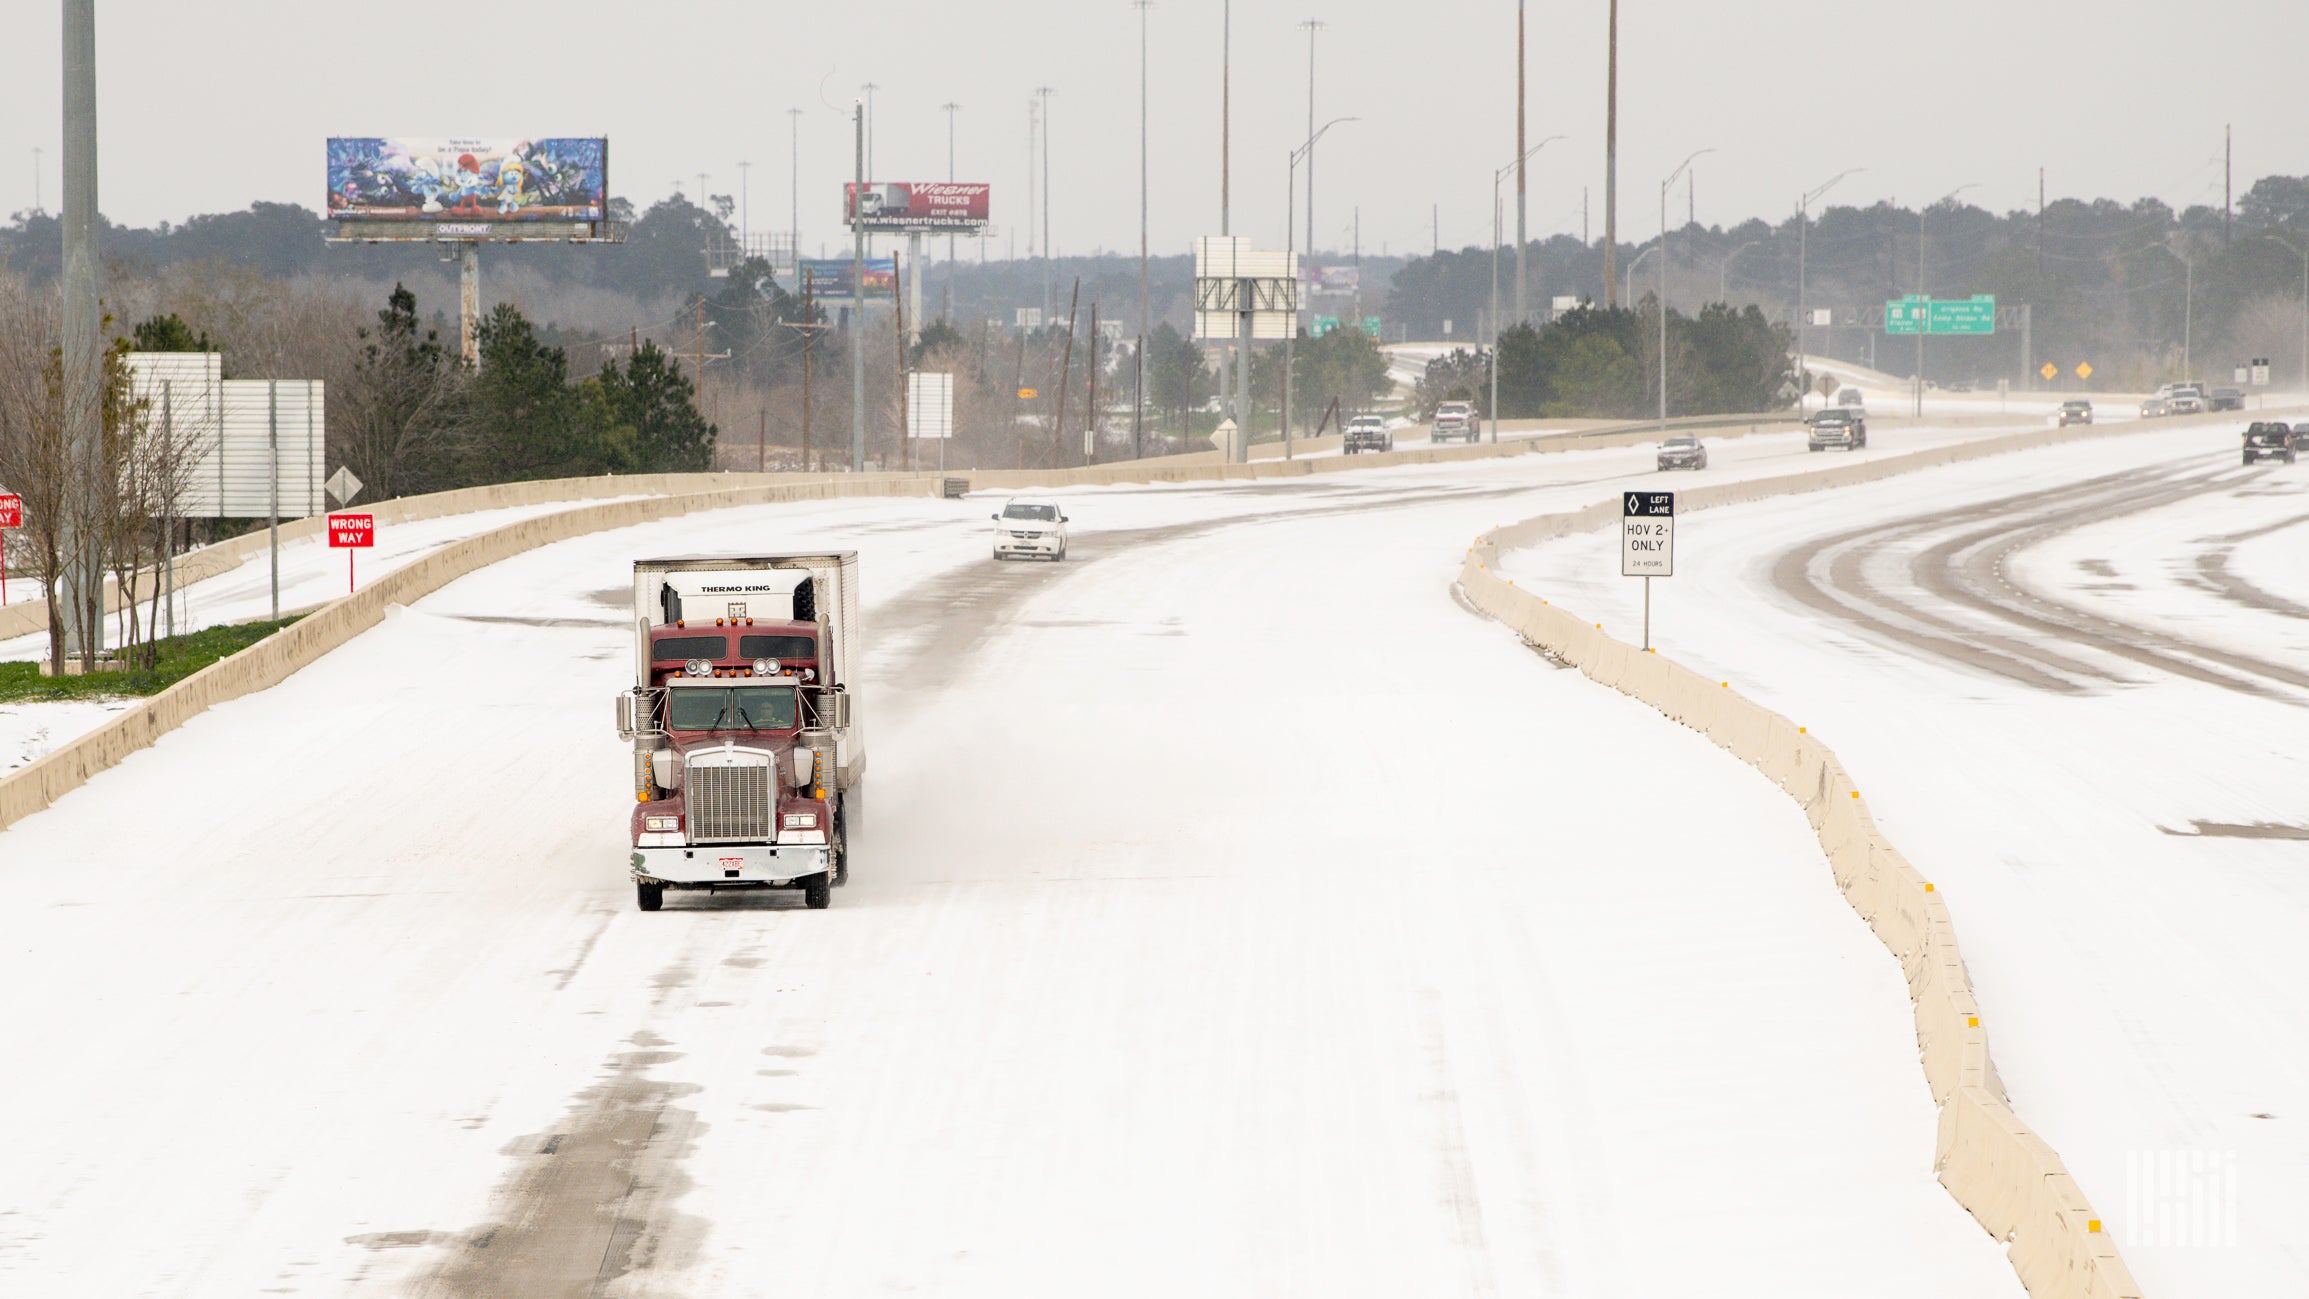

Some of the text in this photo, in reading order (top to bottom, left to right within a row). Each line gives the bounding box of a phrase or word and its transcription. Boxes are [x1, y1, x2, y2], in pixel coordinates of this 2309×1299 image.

[910, 183, 989, 196] Wiesner
[928, 196, 970, 205] TRUCKS
[850, 216, 989, 227] www.wiesnertrucks.com
[438, 223, 488, 233] OUTFRONT
[1650, 496, 1669, 504] LEFT
[1649, 506, 1670, 514] LANE
[330, 518, 372, 530] WRONG
[1627, 524, 1669, 536] HOV 2+
[338, 532, 364, 544] WAY
[1631, 540, 1664, 551] ONLY
